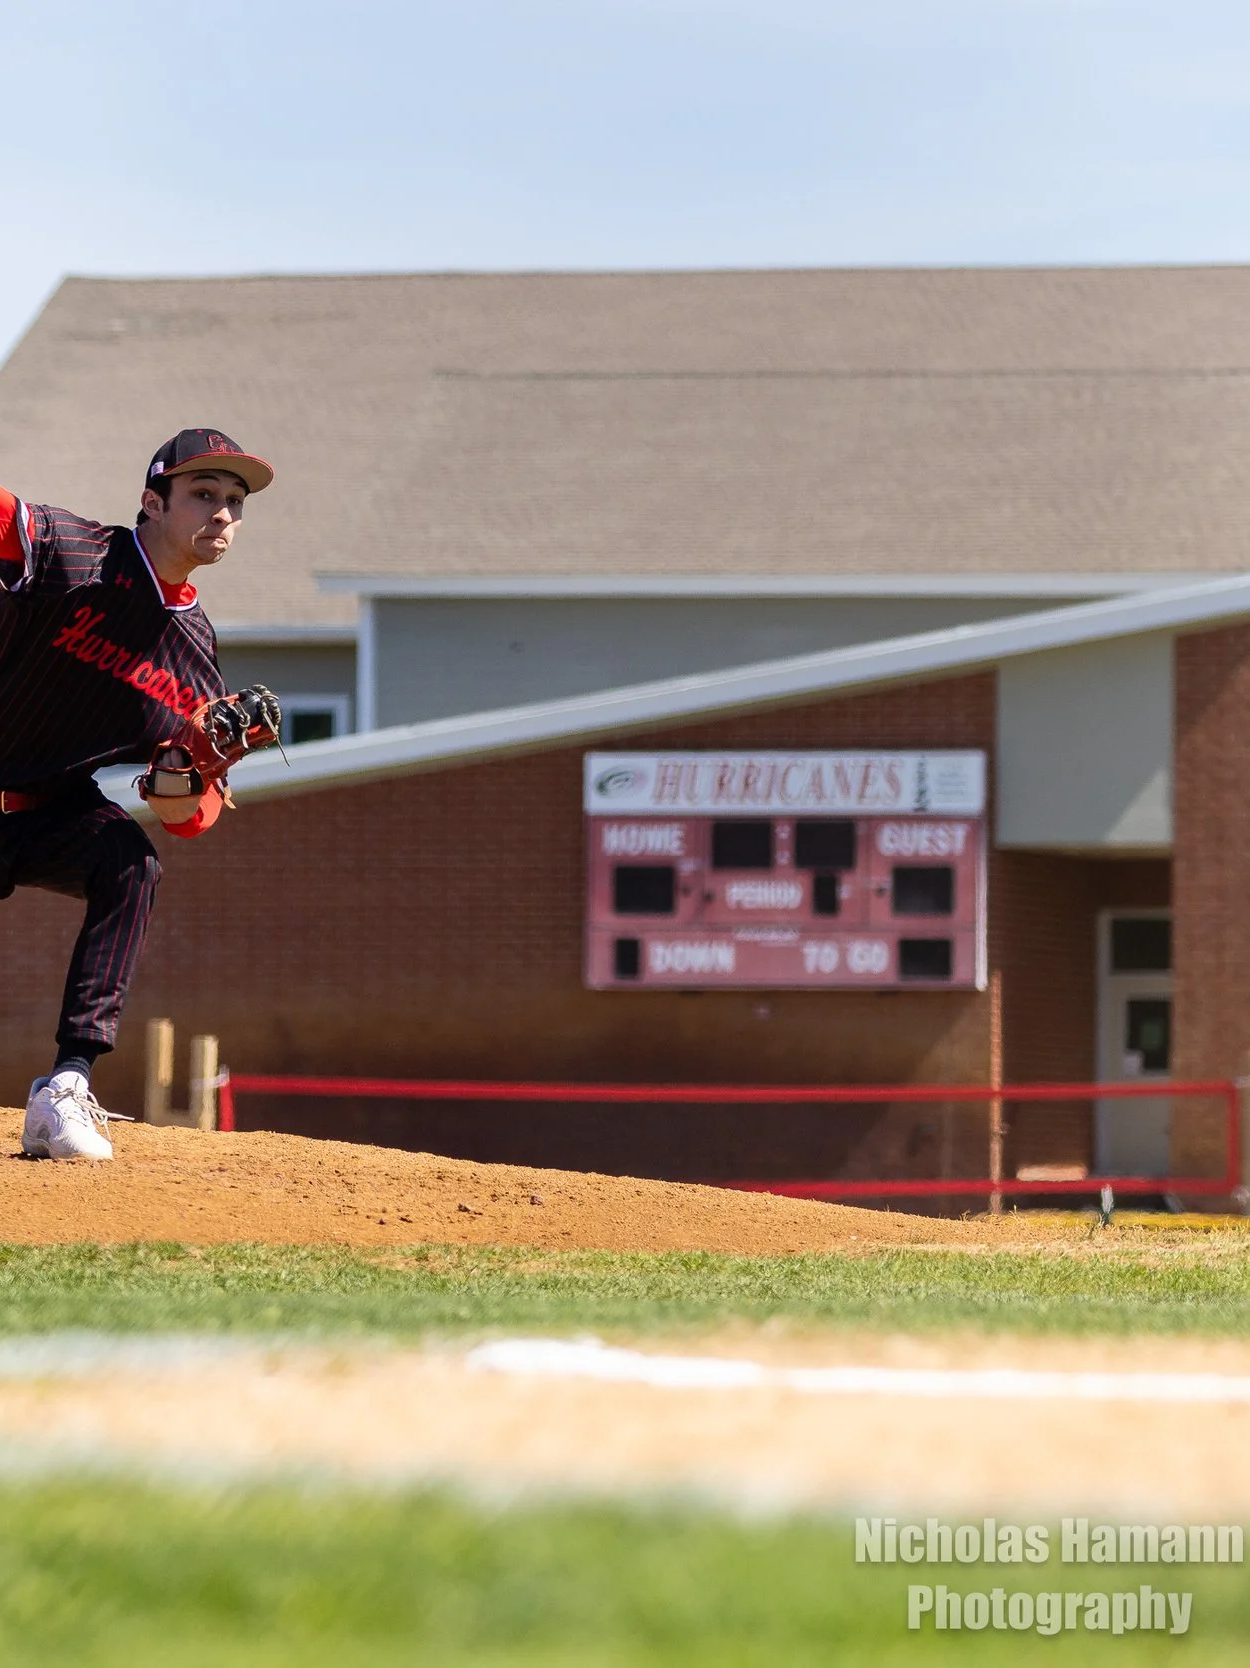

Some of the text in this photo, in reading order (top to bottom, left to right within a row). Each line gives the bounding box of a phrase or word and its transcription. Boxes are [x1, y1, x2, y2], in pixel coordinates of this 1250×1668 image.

[652, 760, 905, 805] HURRICANES
[602, 823, 687, 857] HOME
[878, 823, 971, 857] GUEST
[726, 881, 803, 909] PERIOD
[652, 941, 736, 973] DOWN
[802, 941, 890, 973] TO GO
